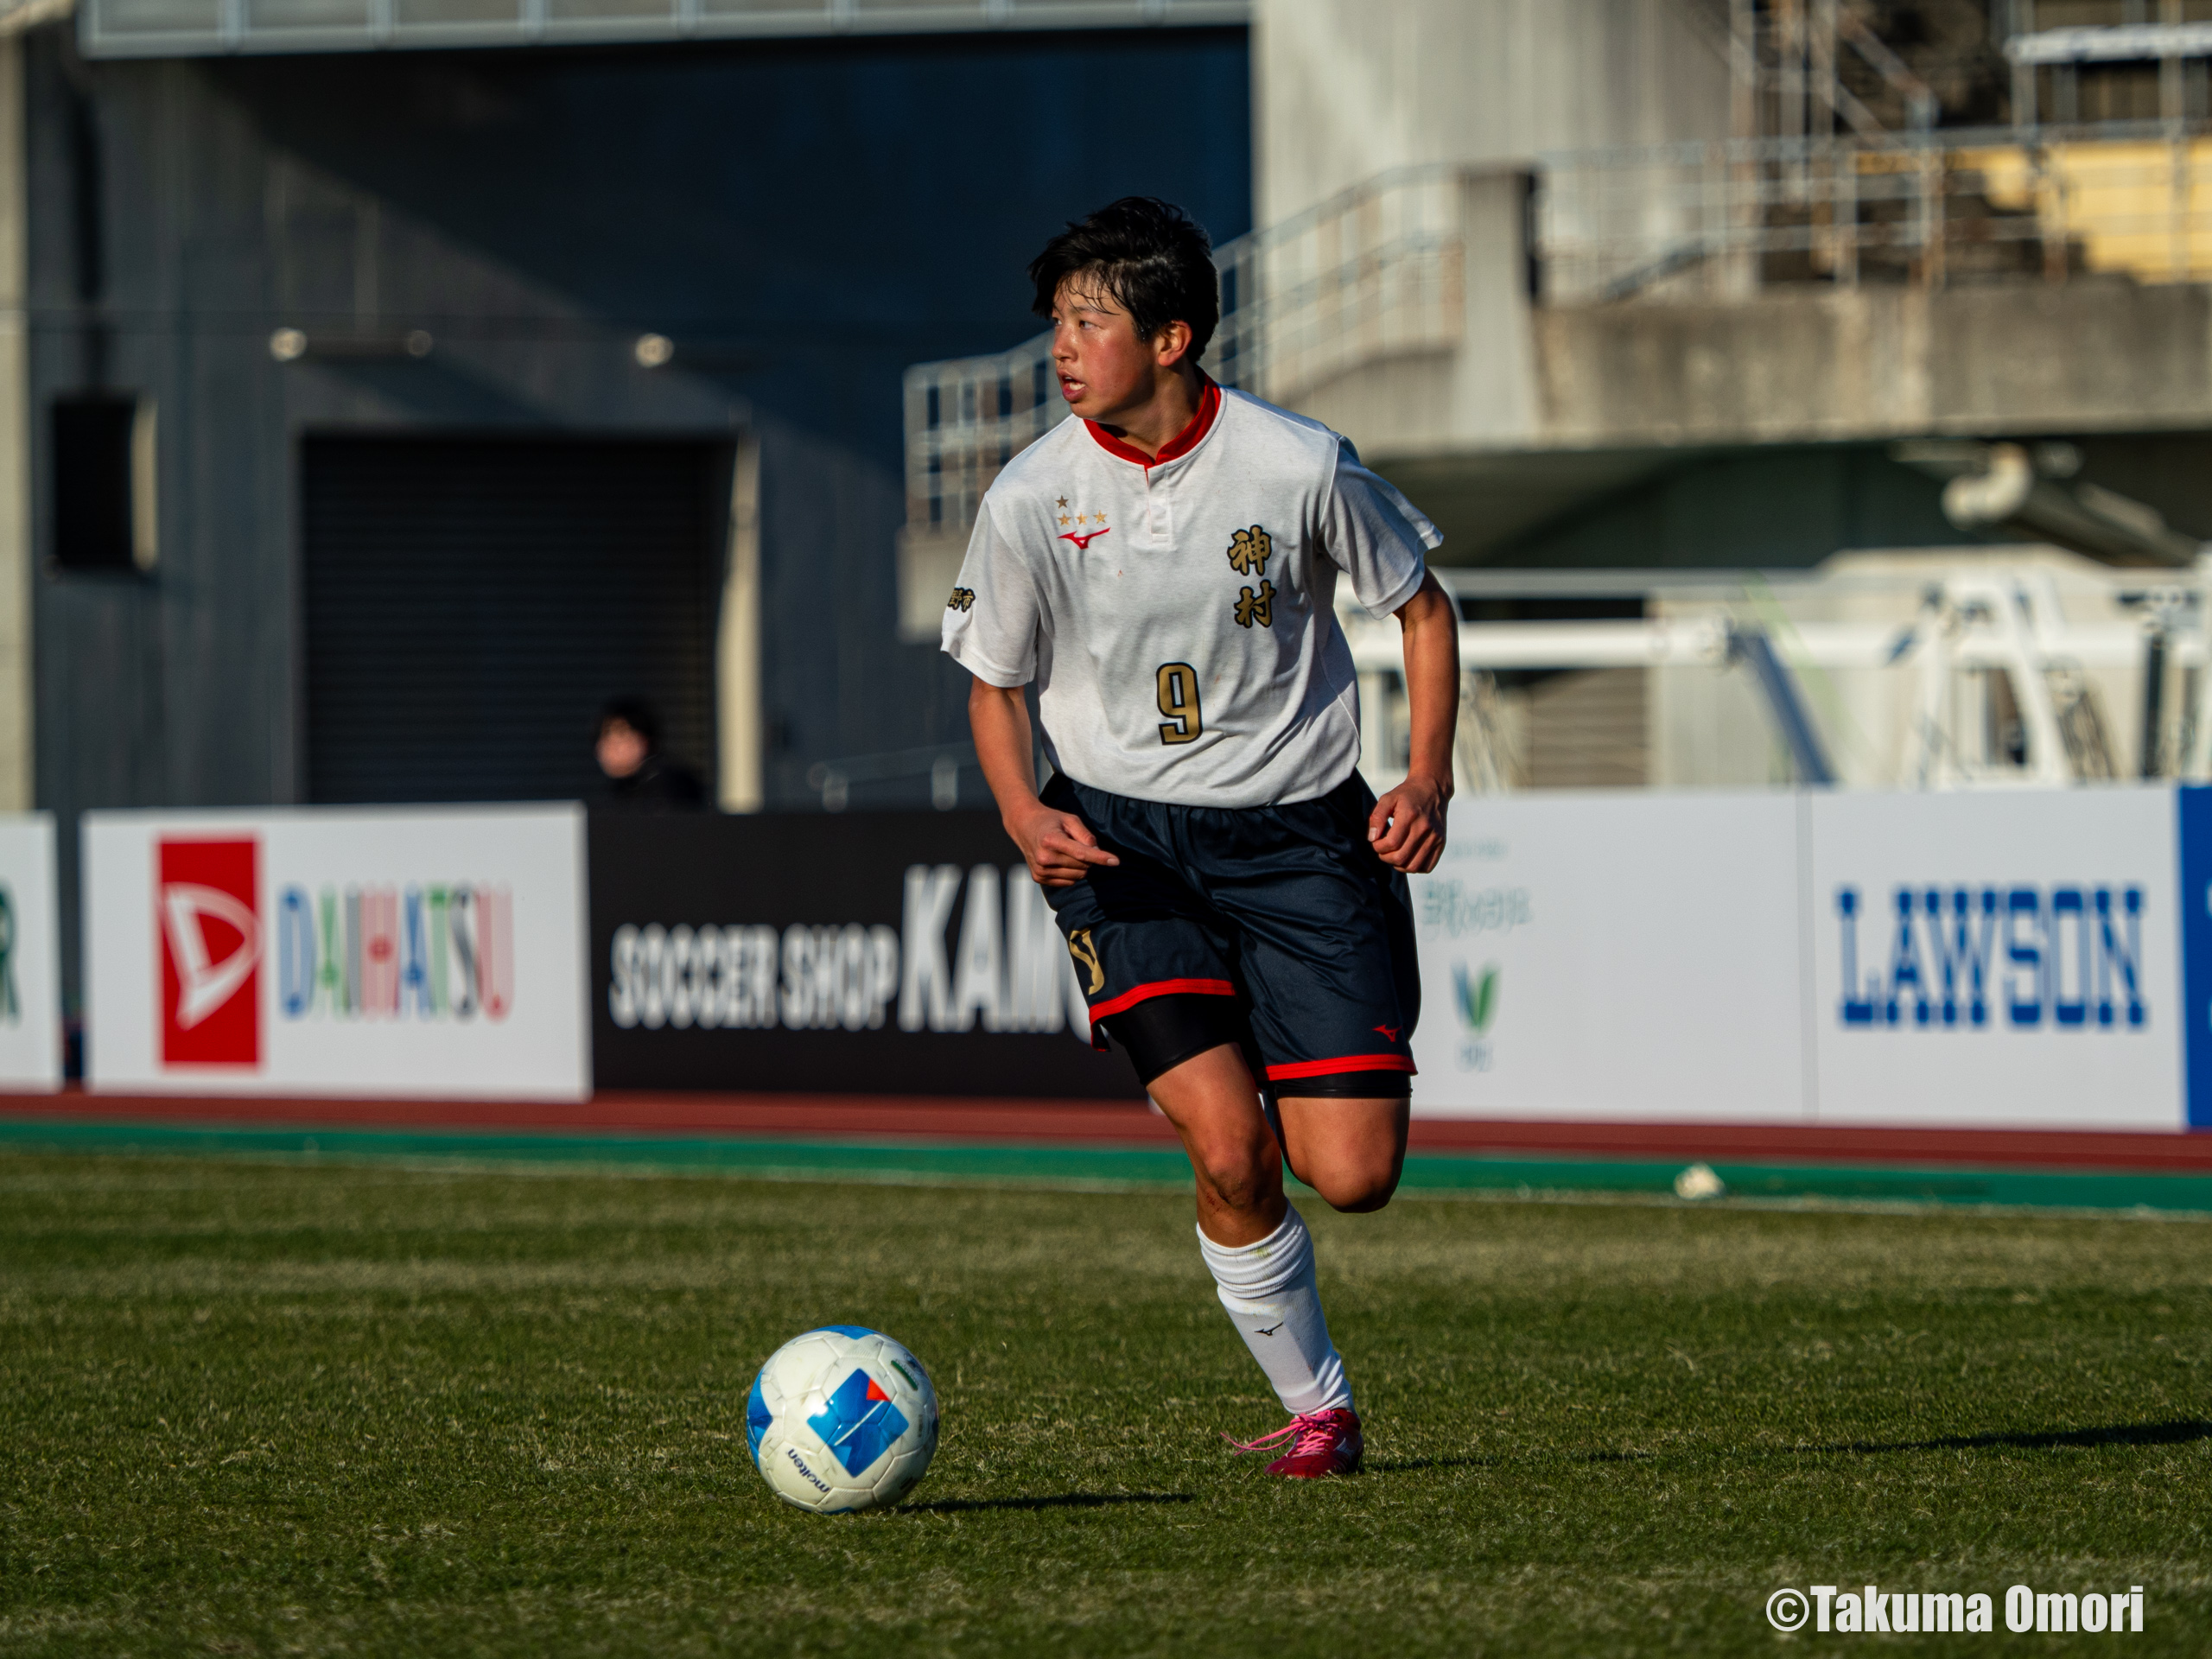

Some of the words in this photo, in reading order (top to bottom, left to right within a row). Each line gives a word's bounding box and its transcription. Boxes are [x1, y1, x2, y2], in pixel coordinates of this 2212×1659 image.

[1227, 524, 1276, 628] 神村
[1156, 662, 1203, 746] 9
[277, 881, 514, 1023] DAIHATSU
[610, 923, 778, 1030] SOCCER
[781, 923, 899, 1031] SHOP
[1837, 883, 2148, 1030] LAWSON
[787, 1448, 830, 1492] molten
